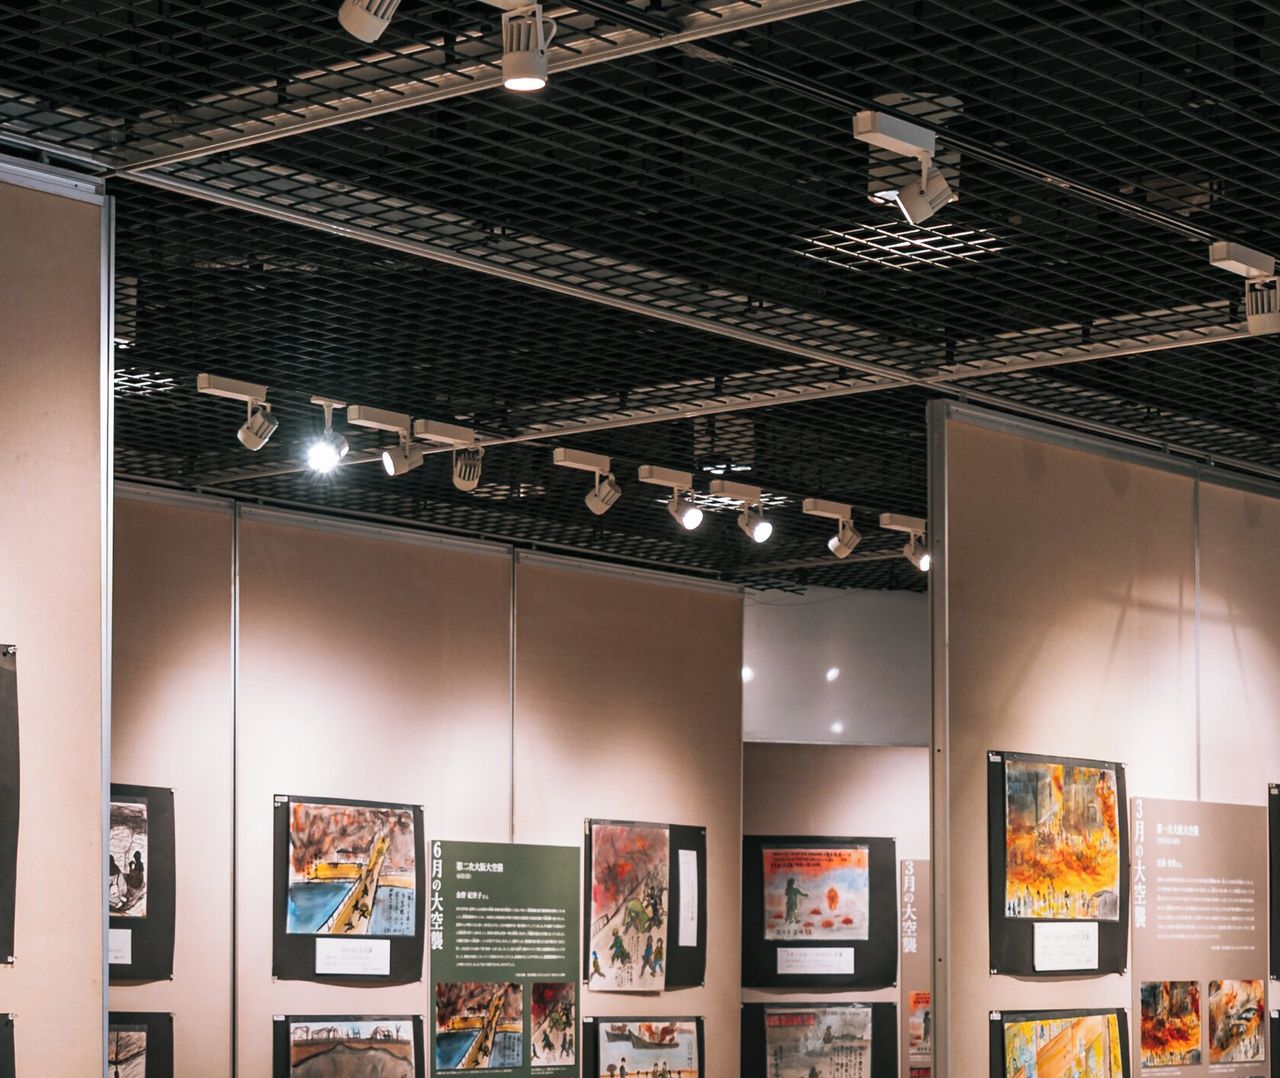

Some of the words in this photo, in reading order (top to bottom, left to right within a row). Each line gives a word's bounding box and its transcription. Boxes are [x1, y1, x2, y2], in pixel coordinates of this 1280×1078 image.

[431, 841, 444, 950] 6月の大空襲
[901, 860, 918, 953] 3月の大空襲
[1134, 799, 1146, 928] 3月の大空襲
